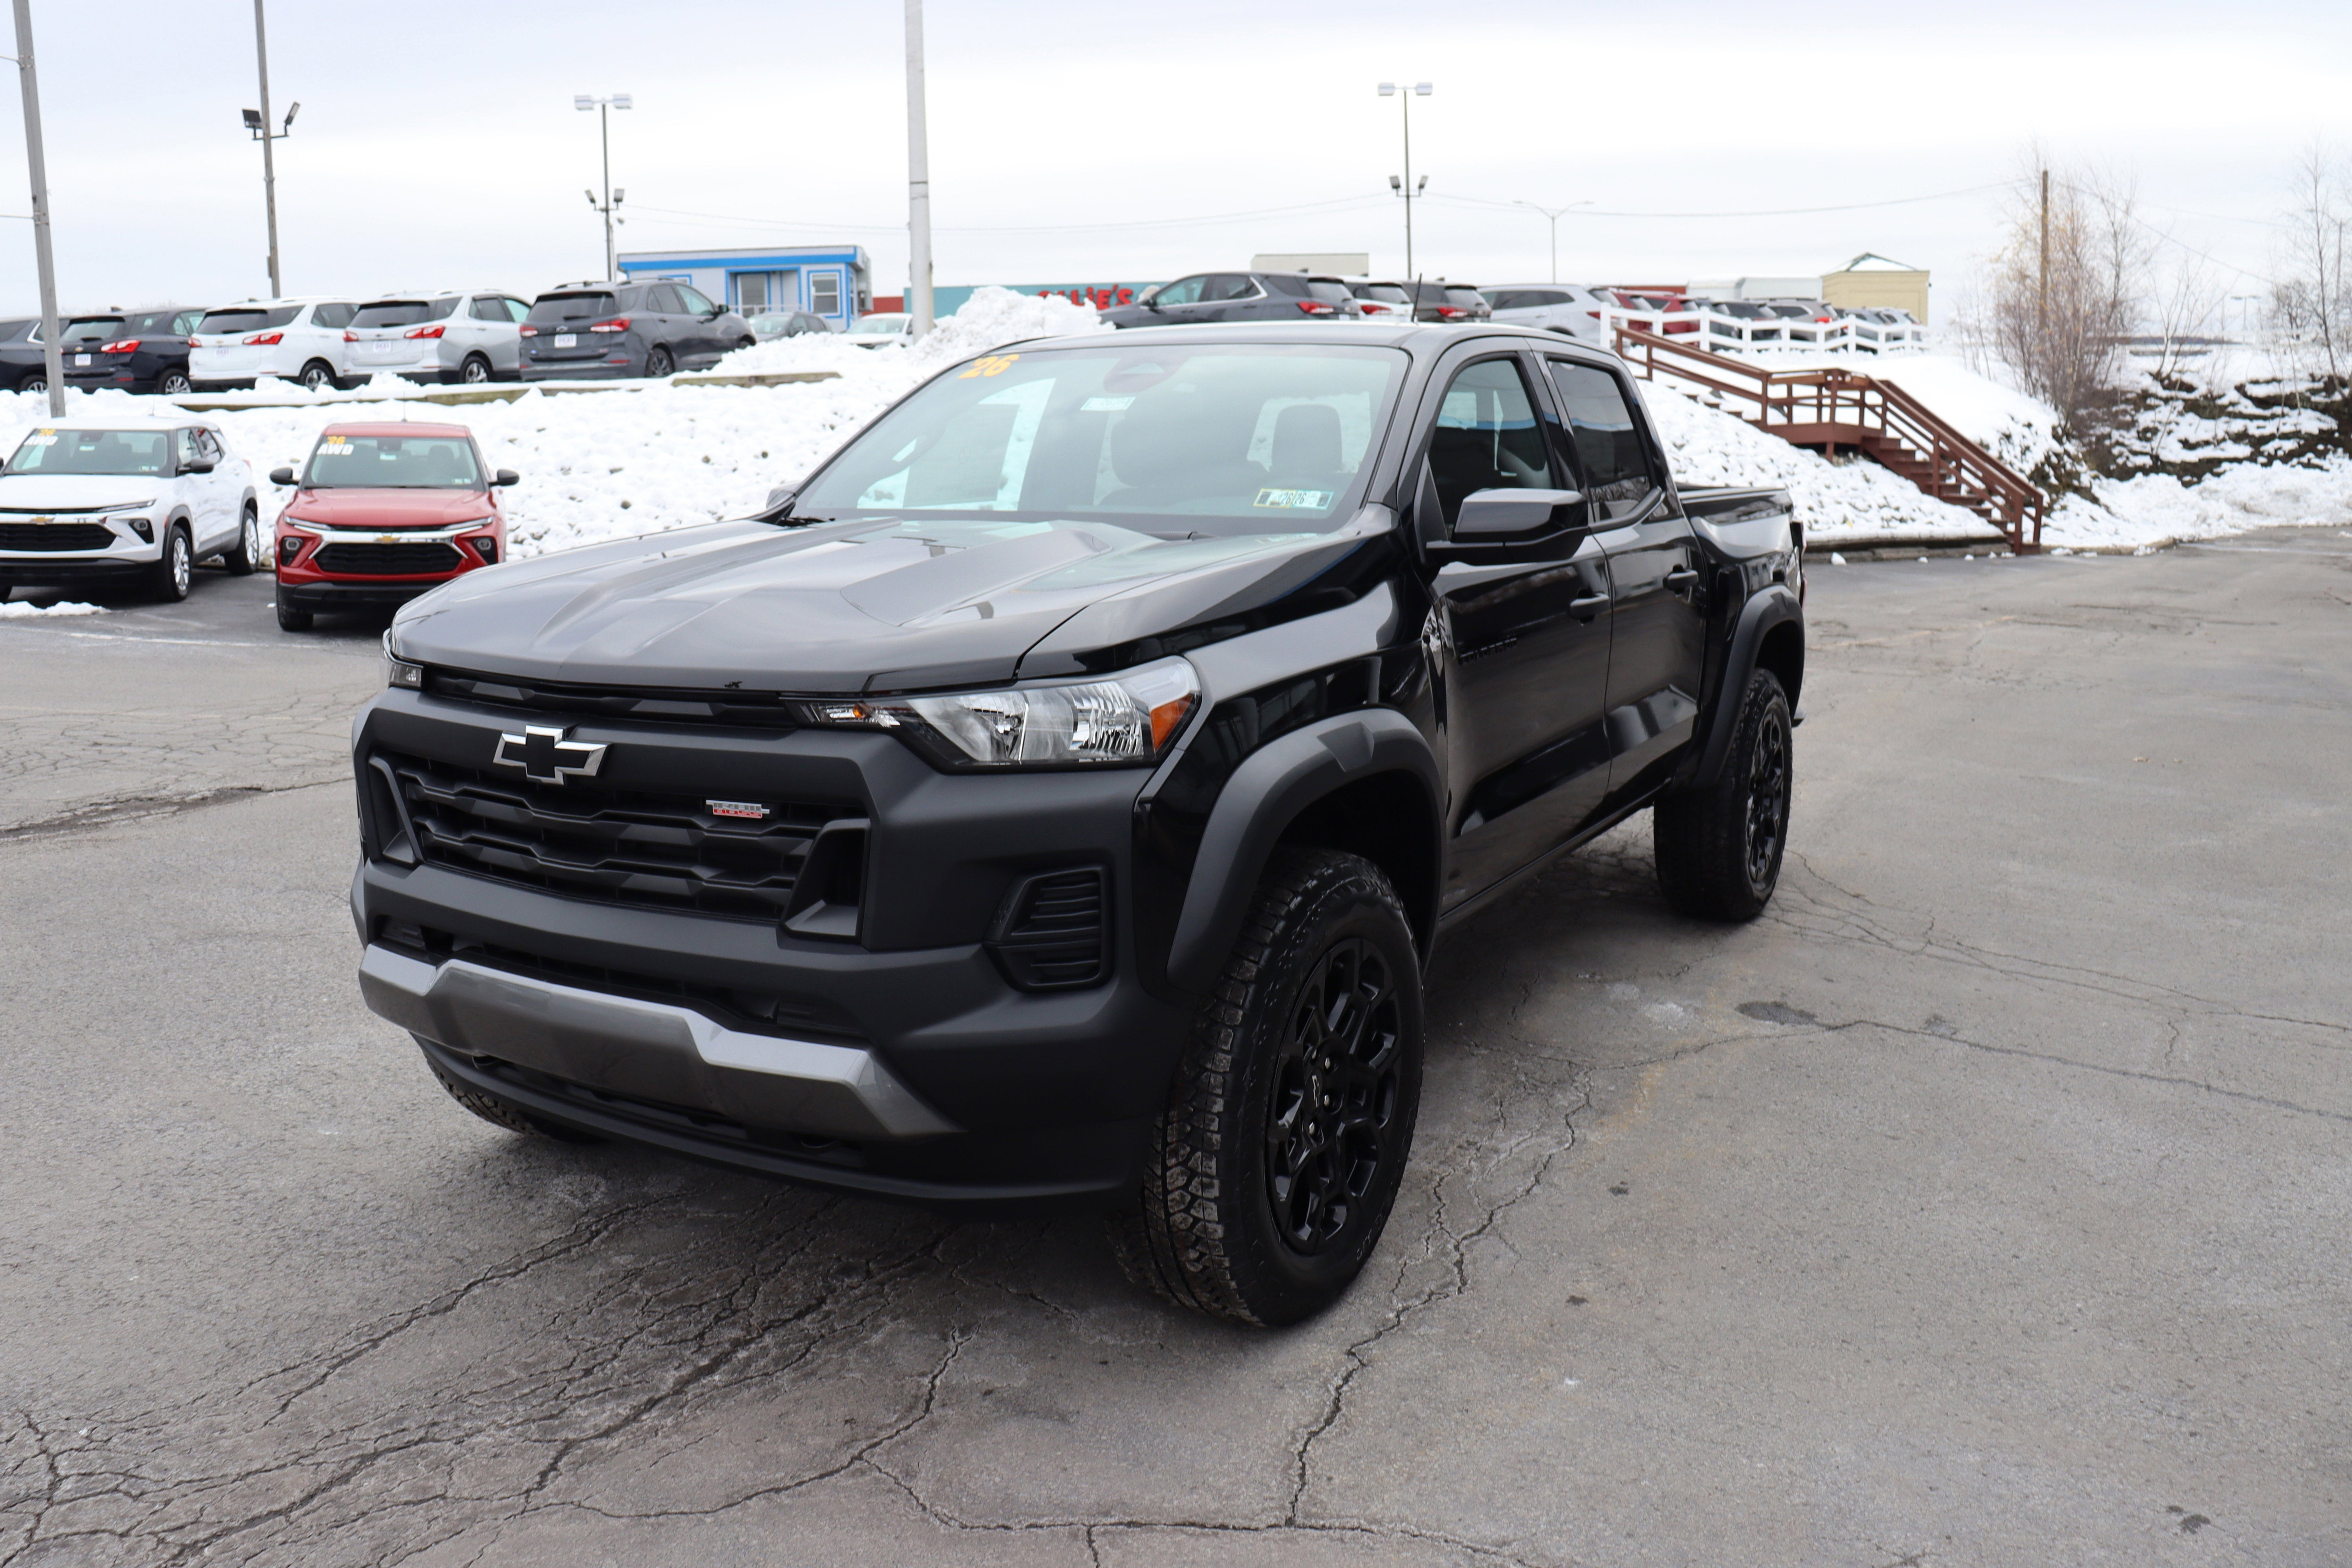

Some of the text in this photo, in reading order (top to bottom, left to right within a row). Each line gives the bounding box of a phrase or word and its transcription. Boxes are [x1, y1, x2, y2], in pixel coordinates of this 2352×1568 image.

[24, 435, 59, 445] AWD
[316, 443, 354, 455] AWD
[1294, 492, 1307, 504] 26
